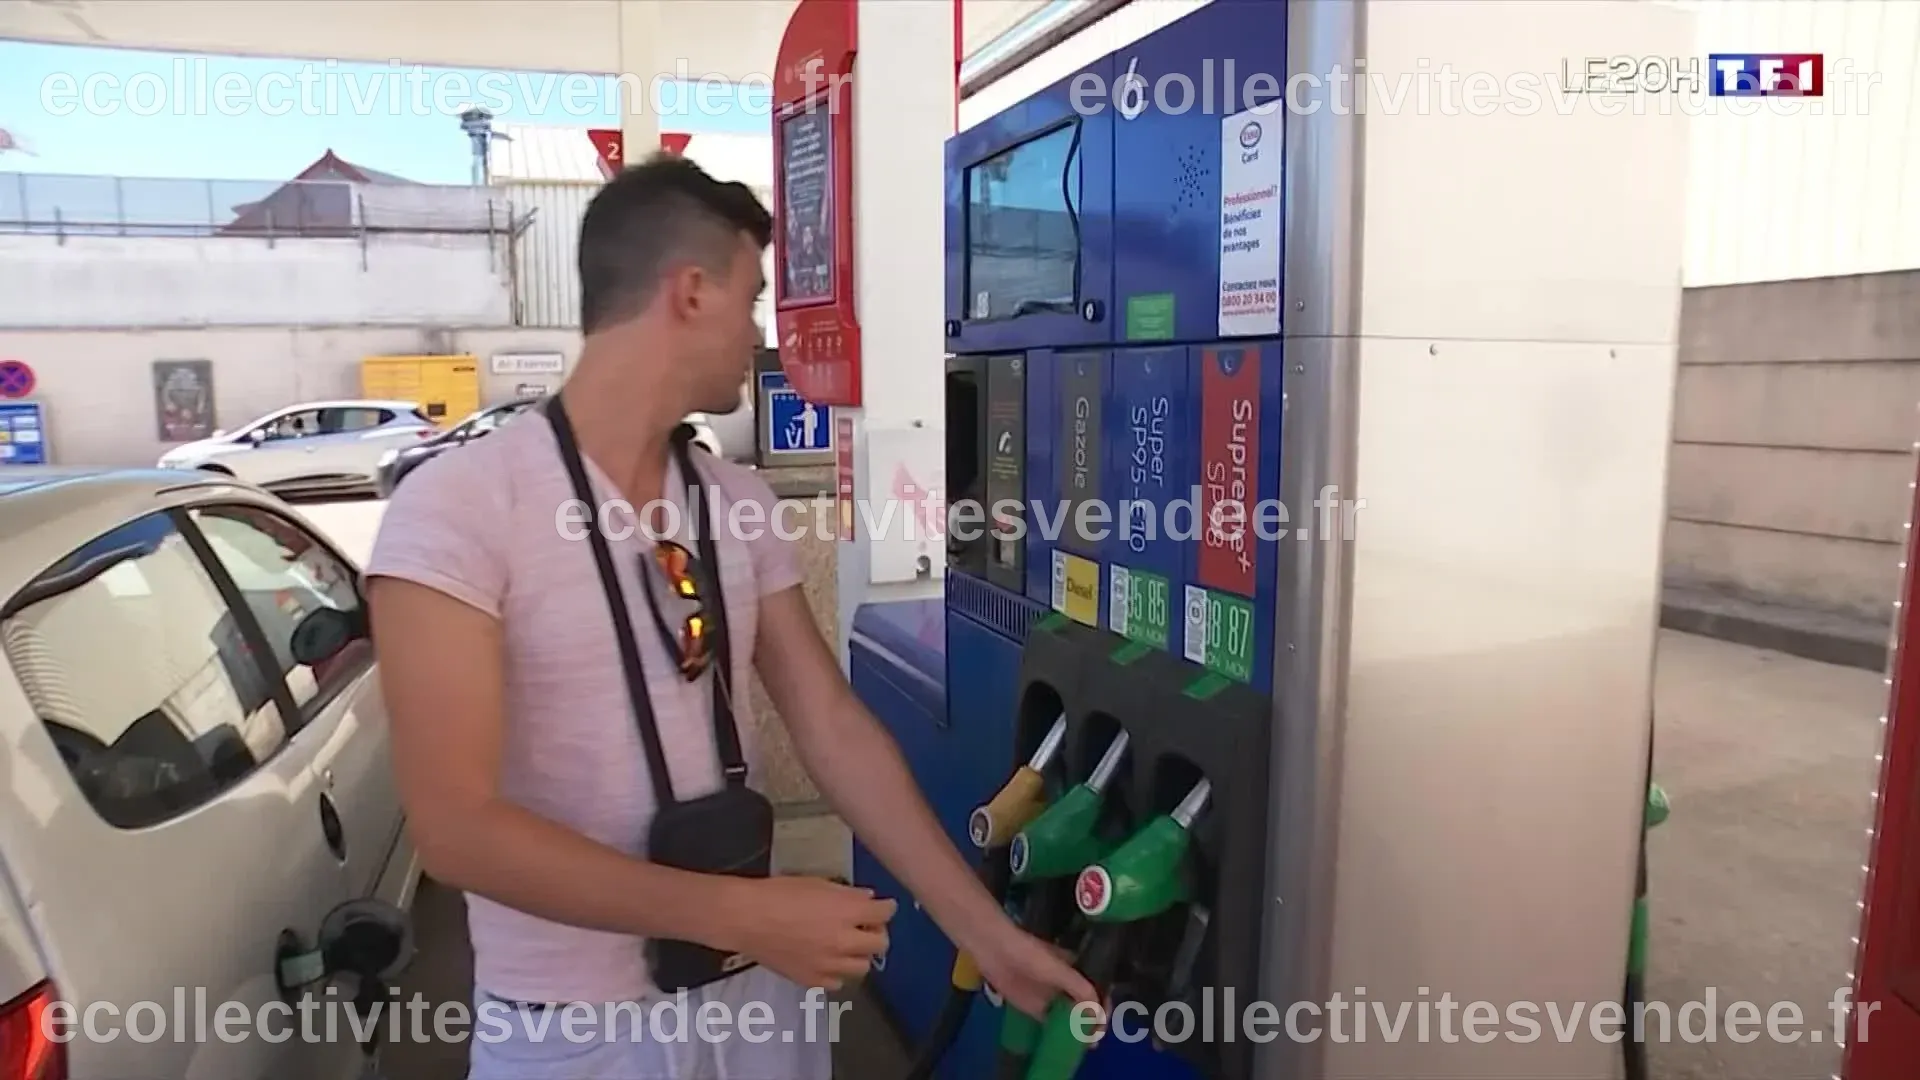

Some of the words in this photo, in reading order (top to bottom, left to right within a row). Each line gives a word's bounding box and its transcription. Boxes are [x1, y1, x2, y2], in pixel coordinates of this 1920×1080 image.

[1121, 56, 1144, 120] 6
[607, 142, 620, 160] 2
[1223, 240, 1260, 254] avantages
[1234, 227, 1247, 237] nos
[1074, 396, 1089, 489] Gazole
[1150, 396, 1169, 488] Super
[1130, 406, 1149, 552] SP95-E10
[1206, 461, 1225, 548] SP98
[1148, 578, 1165, 627] 85
[1228, 604, 1249, 659] 87
